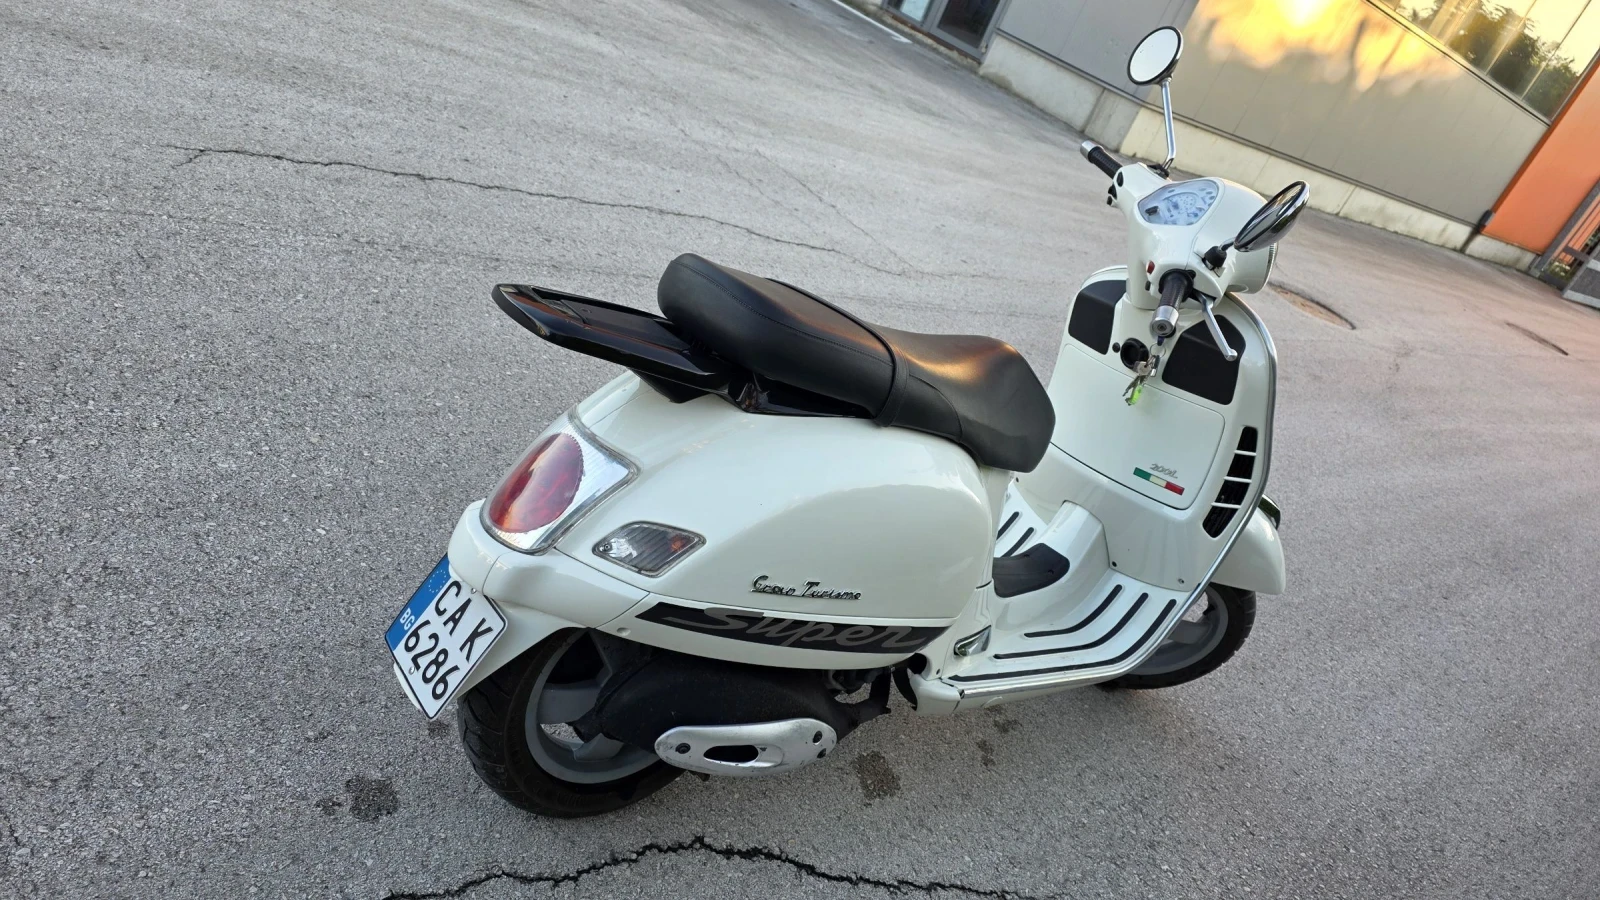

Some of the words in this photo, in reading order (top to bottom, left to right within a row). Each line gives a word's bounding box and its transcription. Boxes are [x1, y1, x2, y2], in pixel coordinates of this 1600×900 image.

[752, 575, 797, 596] Gran
[801, 580, 862, 600] Turismo
[400, 607, 416, 631] BG
[434, 580, 473, 636] CA
[459, 617, 494, 664] K
[662, 607, 927, 648] Super
[404, 619, 461, 701] 6286
